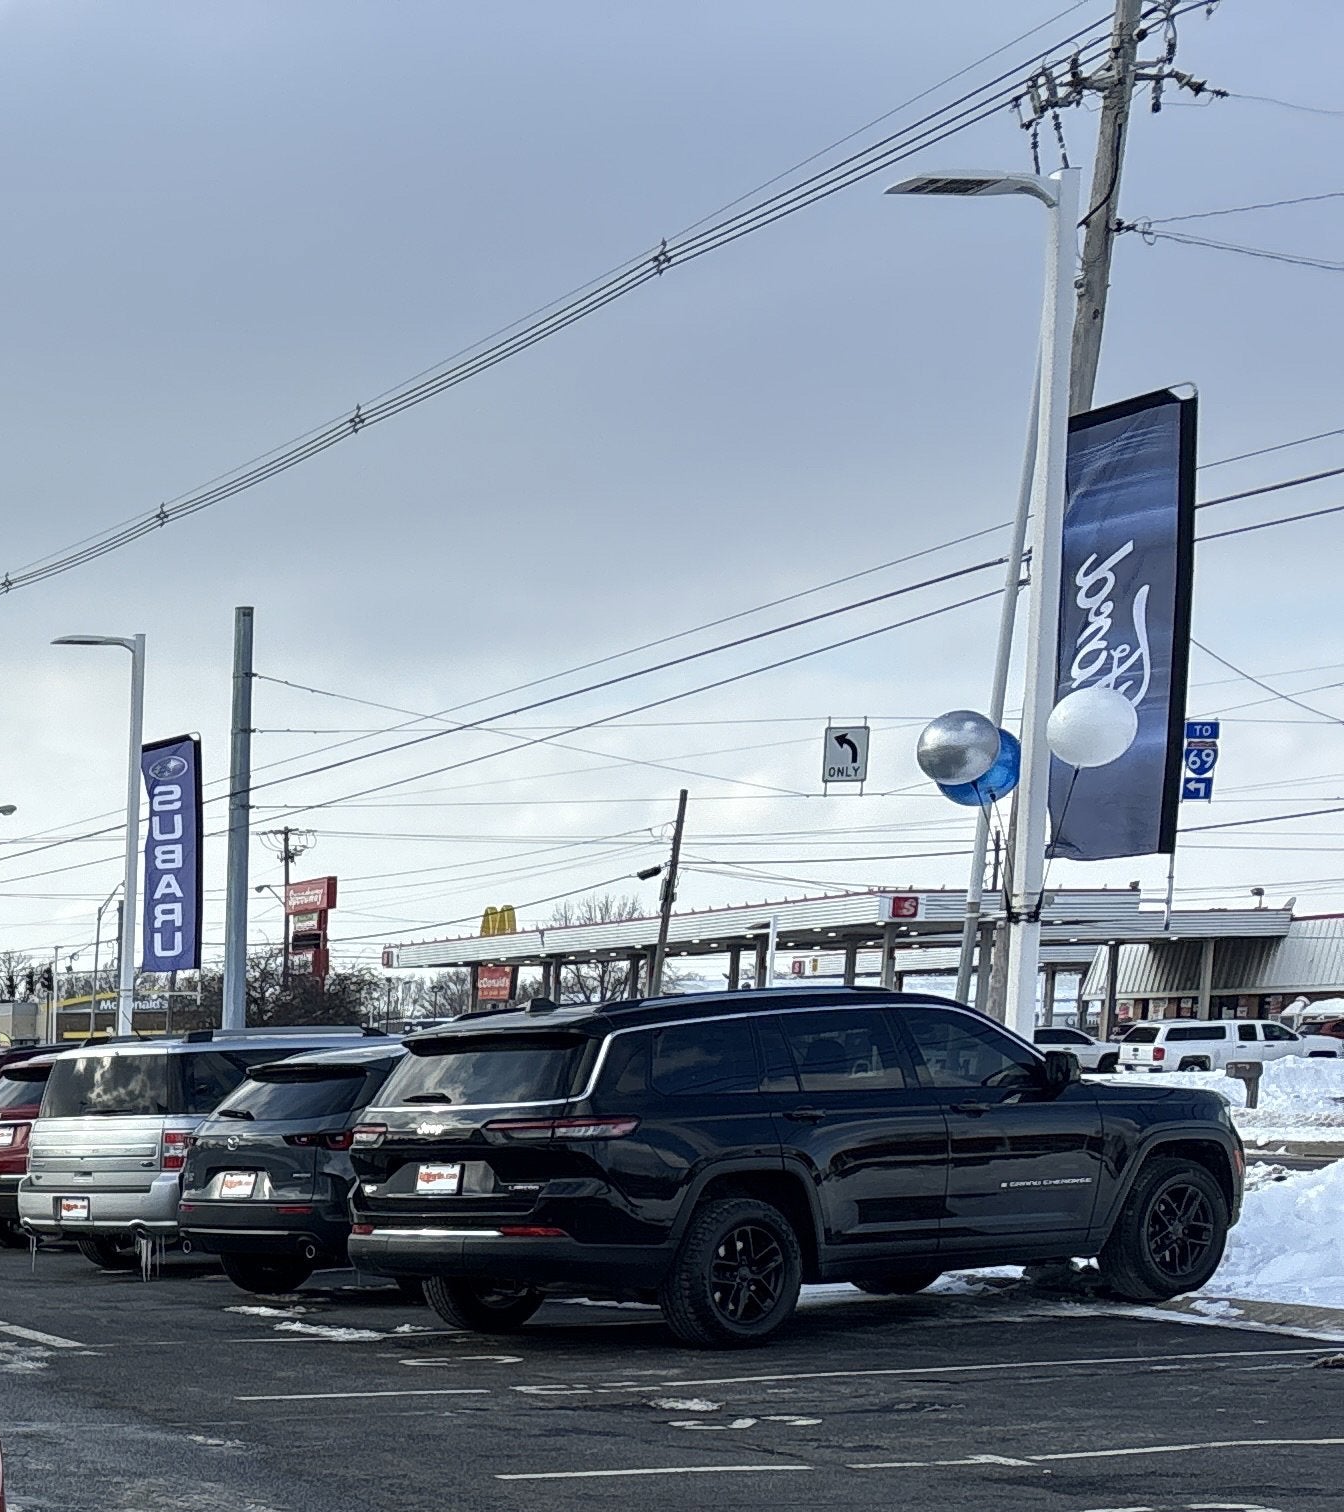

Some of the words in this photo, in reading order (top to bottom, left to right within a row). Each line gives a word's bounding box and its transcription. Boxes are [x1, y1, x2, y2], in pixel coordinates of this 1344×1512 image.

[1194, 725, 1211, 737] TO
[1188, 749, 1215, 770] 69
[828, 766, 861, 778] ONLY
[416, 1122, 445, 1136] Jeep
